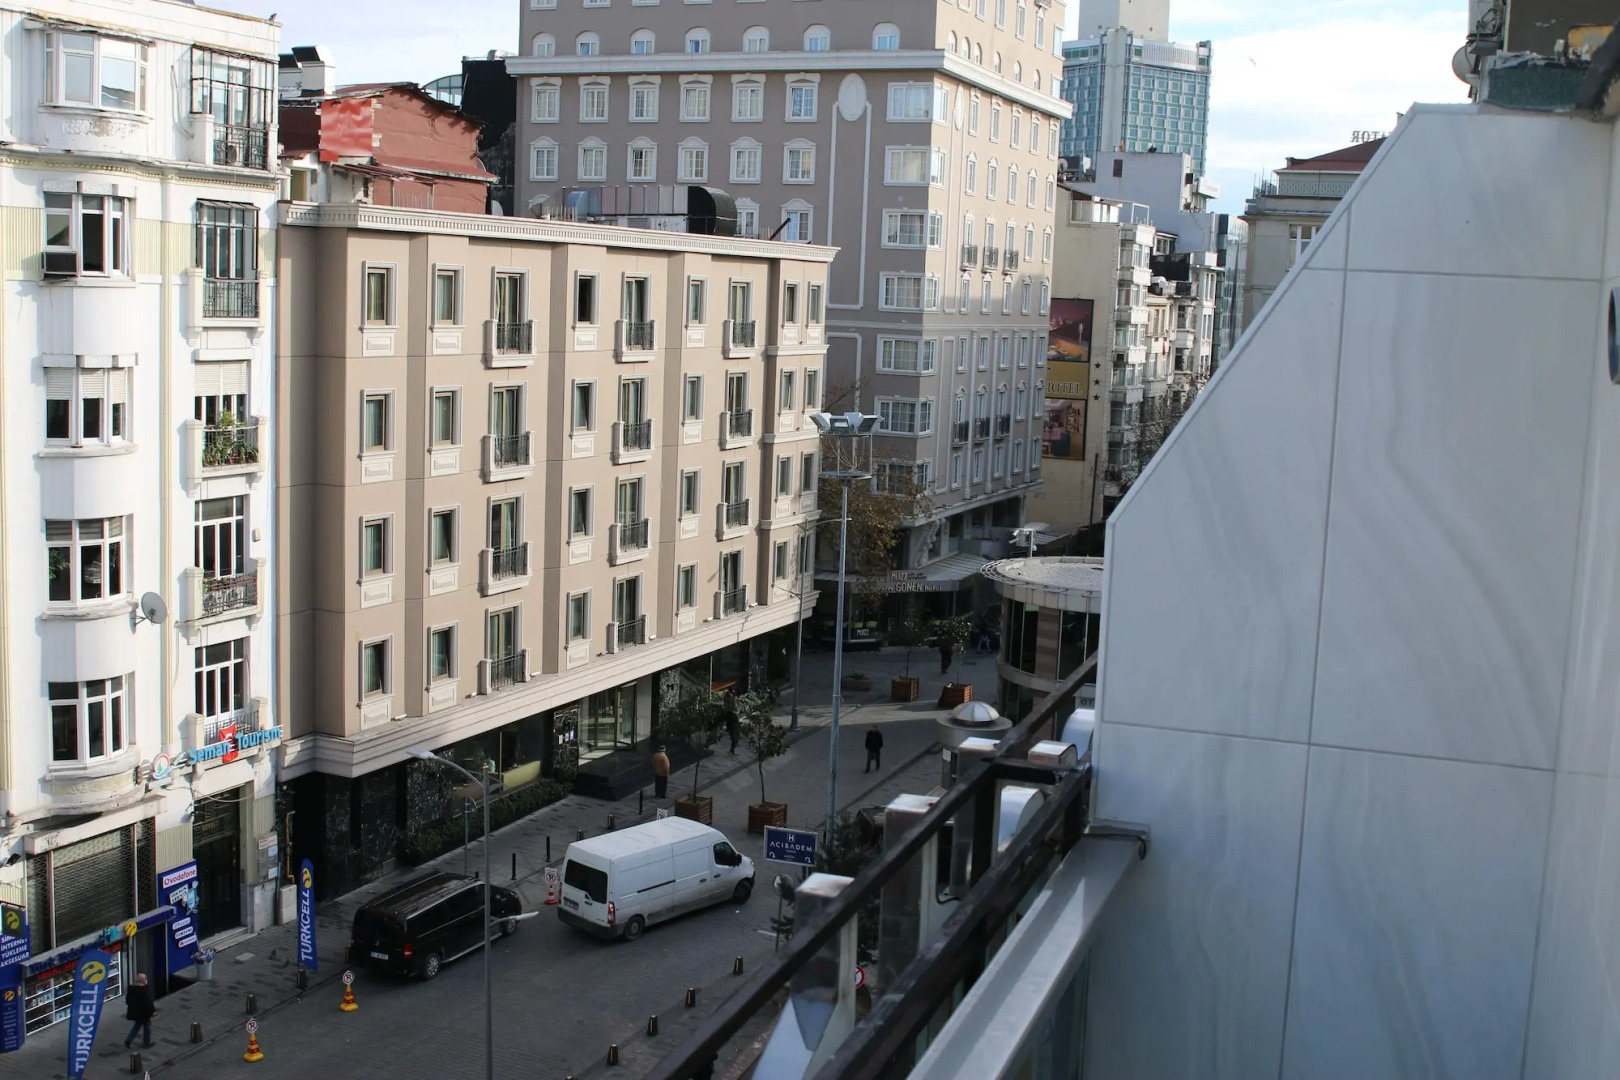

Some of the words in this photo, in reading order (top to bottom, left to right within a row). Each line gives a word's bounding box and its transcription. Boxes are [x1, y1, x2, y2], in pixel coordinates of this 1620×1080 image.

[188, 742, 230, 766] Seman
[235, 727, 281, 751] Tourism
[769, 841, 813, 853] ACIBADEM
[169, 869, 196, 884] vodafone
[300, 889, 313, 961] TURKCELL
[0, 951, 30, 968] AKSESUAR
[75, 983, 99, 1073] TURKCELL
